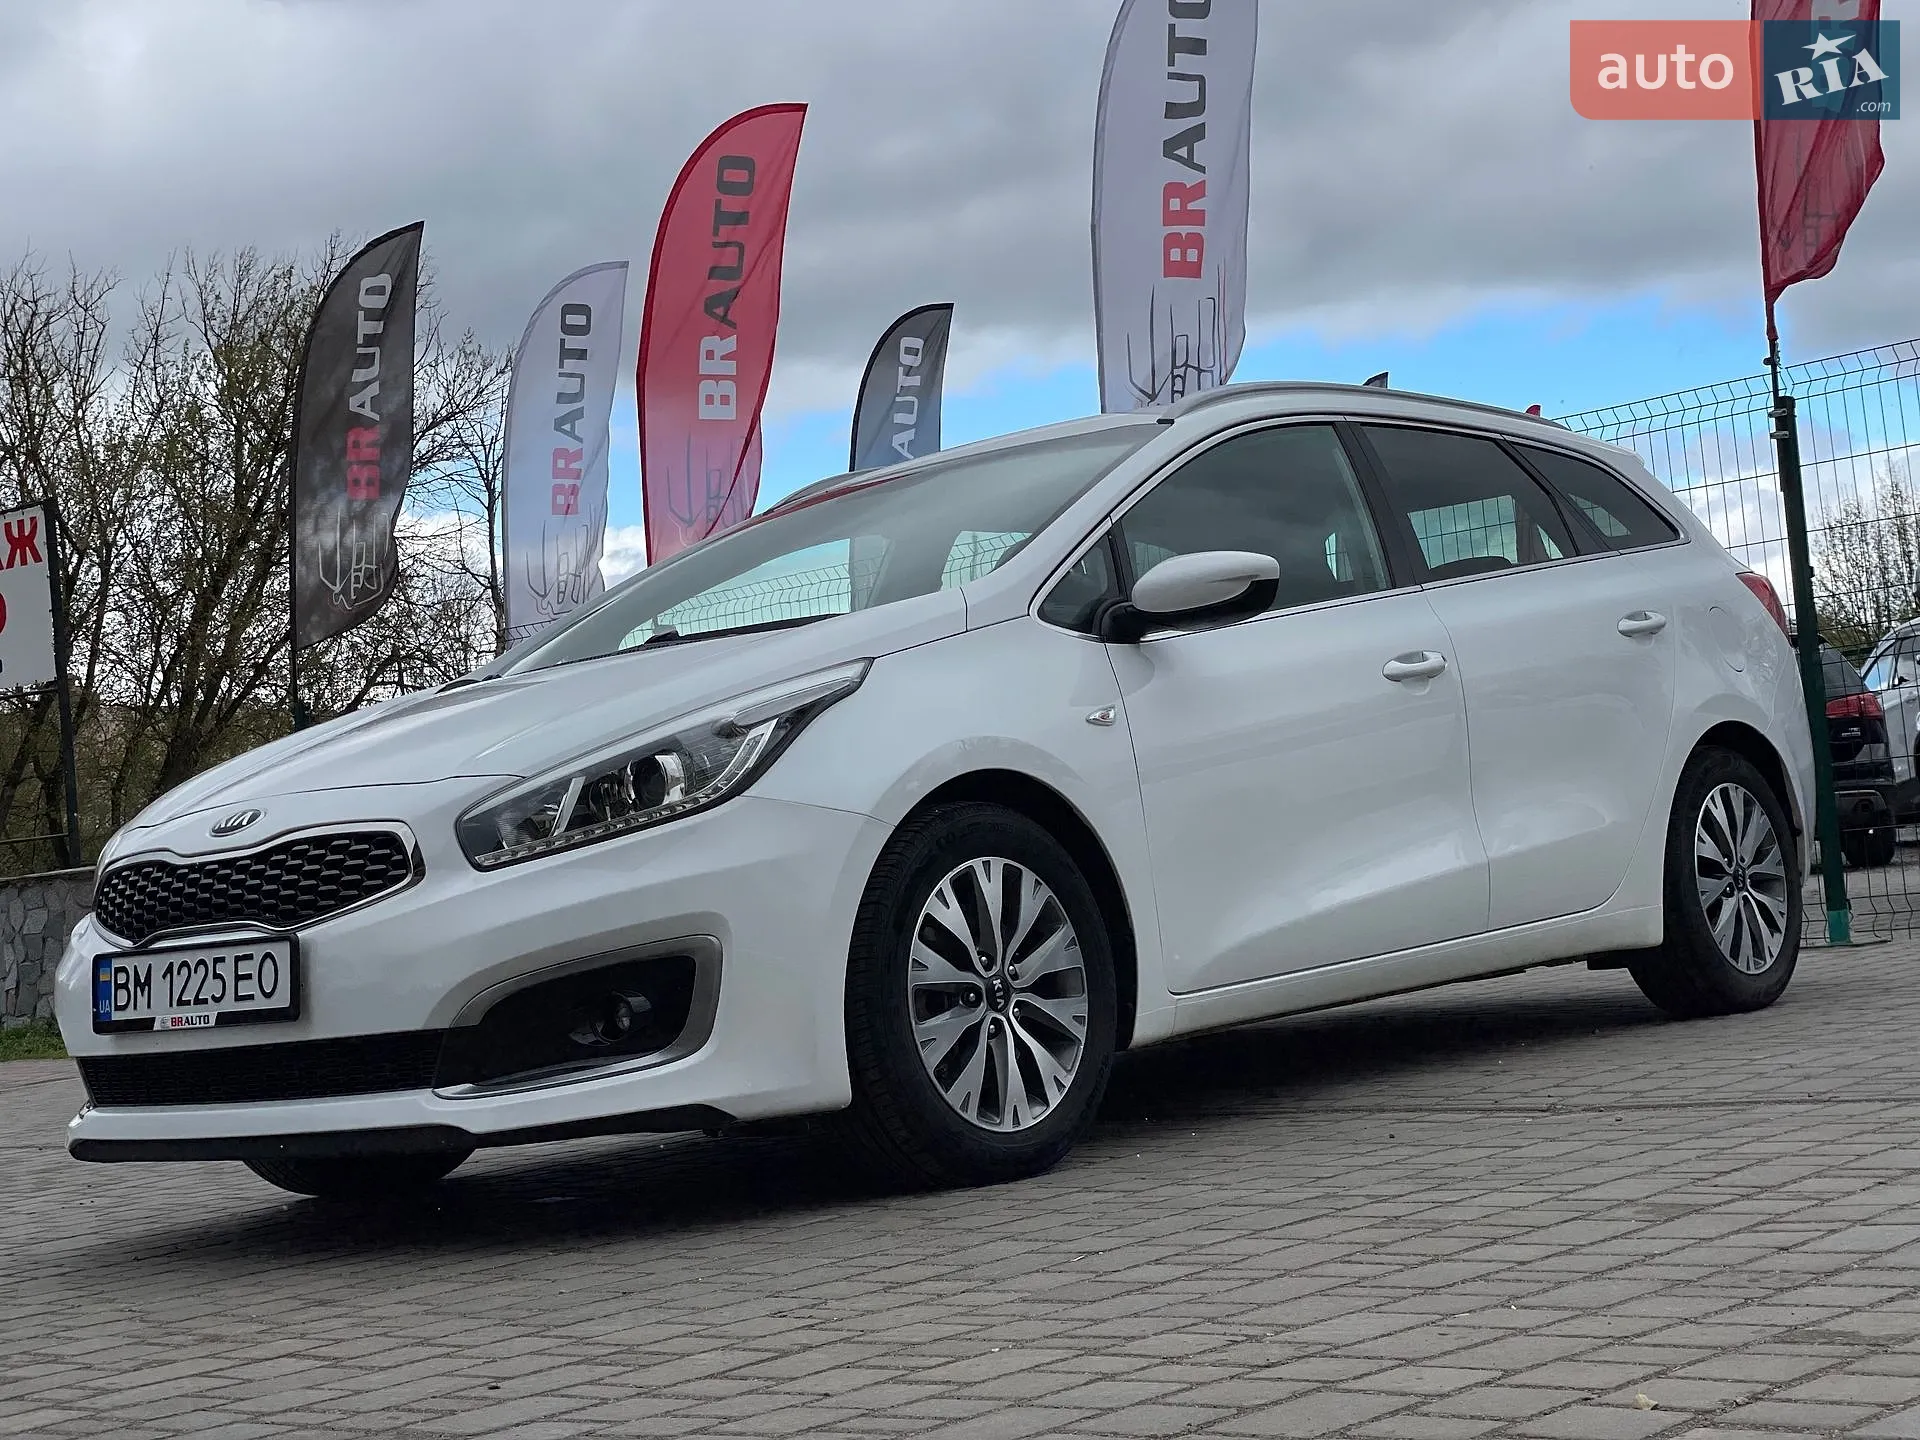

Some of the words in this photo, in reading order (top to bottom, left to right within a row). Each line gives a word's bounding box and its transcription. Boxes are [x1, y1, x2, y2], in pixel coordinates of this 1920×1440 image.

[698, 154, 756, 421] BRAUTO
[345, 272, 393, 500] BRAUTO
[551, 303, 592, 516] BRAUTO
[213, 810, 254, 830] KIA
[113, 962, 152, 1012] BM
[161, 955, 227, 1009] 1225
[233, 950, 279, 1002] EO
[992, 978, 1005, 1010] KIA
[99, 998, 111, 1015] UA
[170, 1013, 210, 1027] BRAUTO
